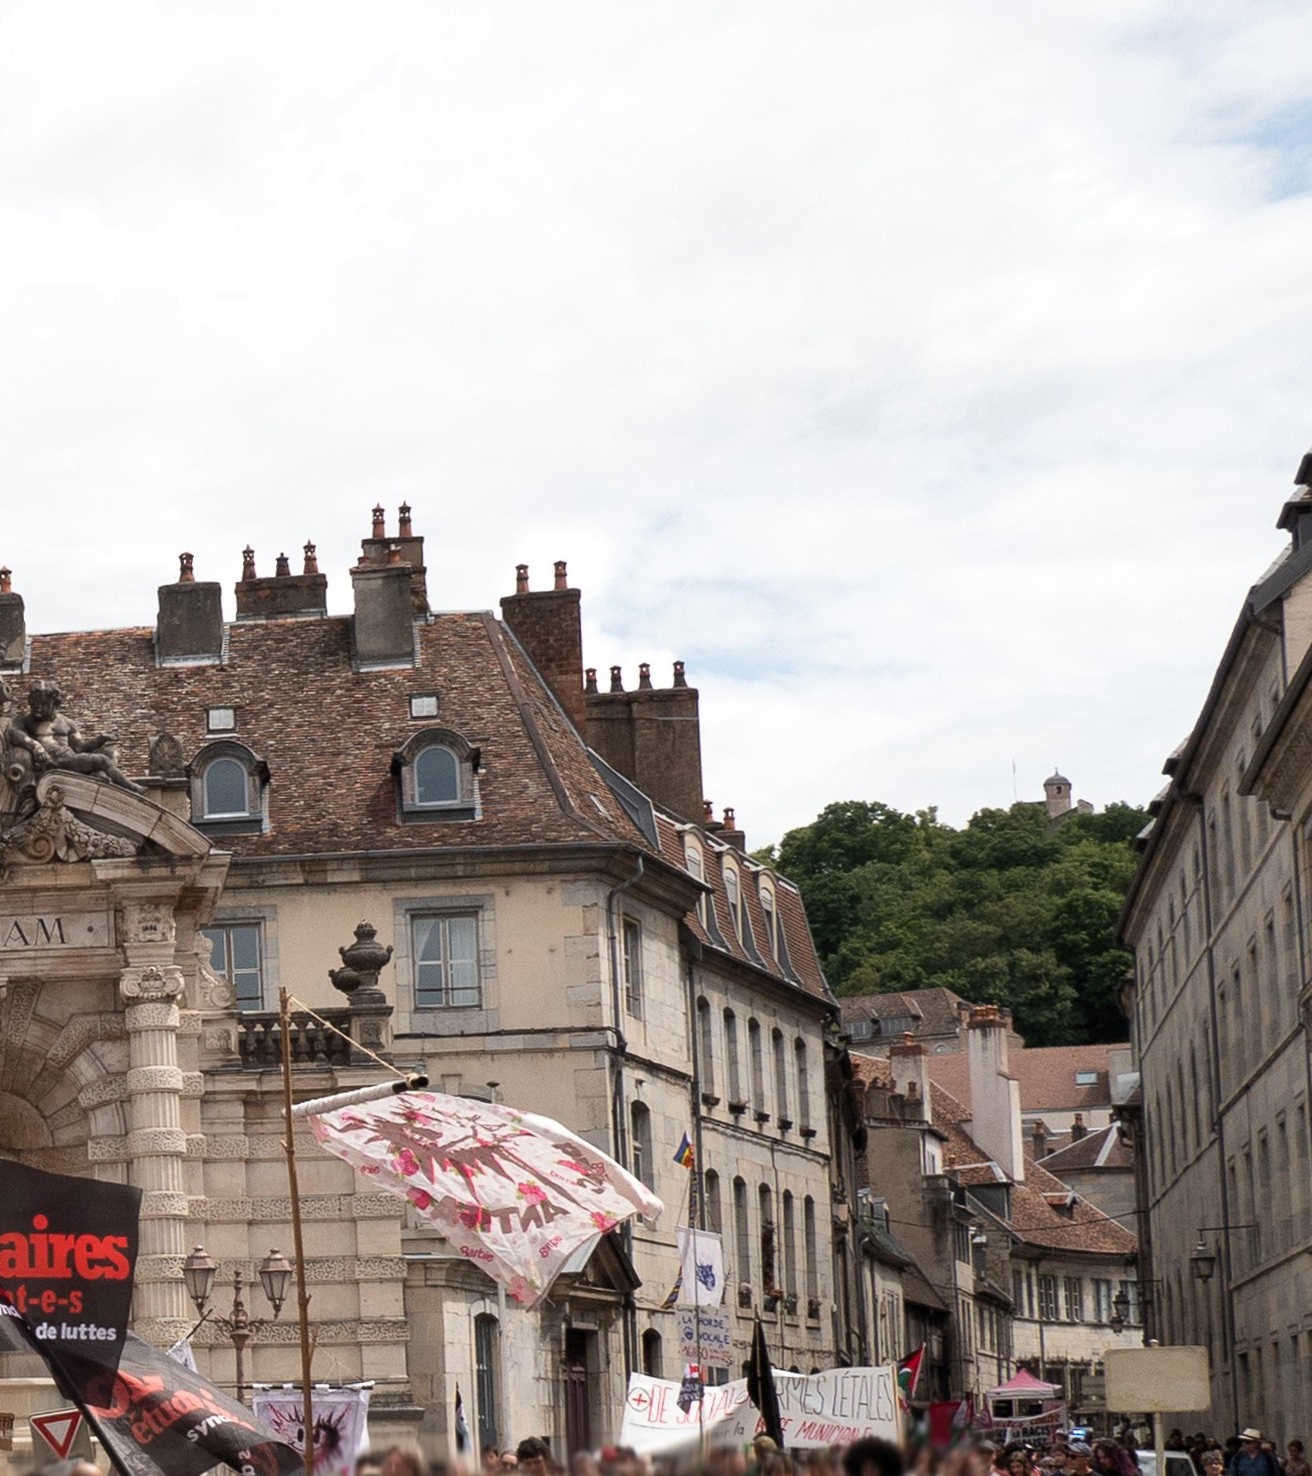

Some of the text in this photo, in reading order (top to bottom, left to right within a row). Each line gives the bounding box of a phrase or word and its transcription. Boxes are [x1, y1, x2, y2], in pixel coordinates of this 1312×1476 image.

[35, 1322, 57, 1340] de
[61, 1322, 117, 1341] luttes
[831, 1370, 894, 1422] LÉTALES
